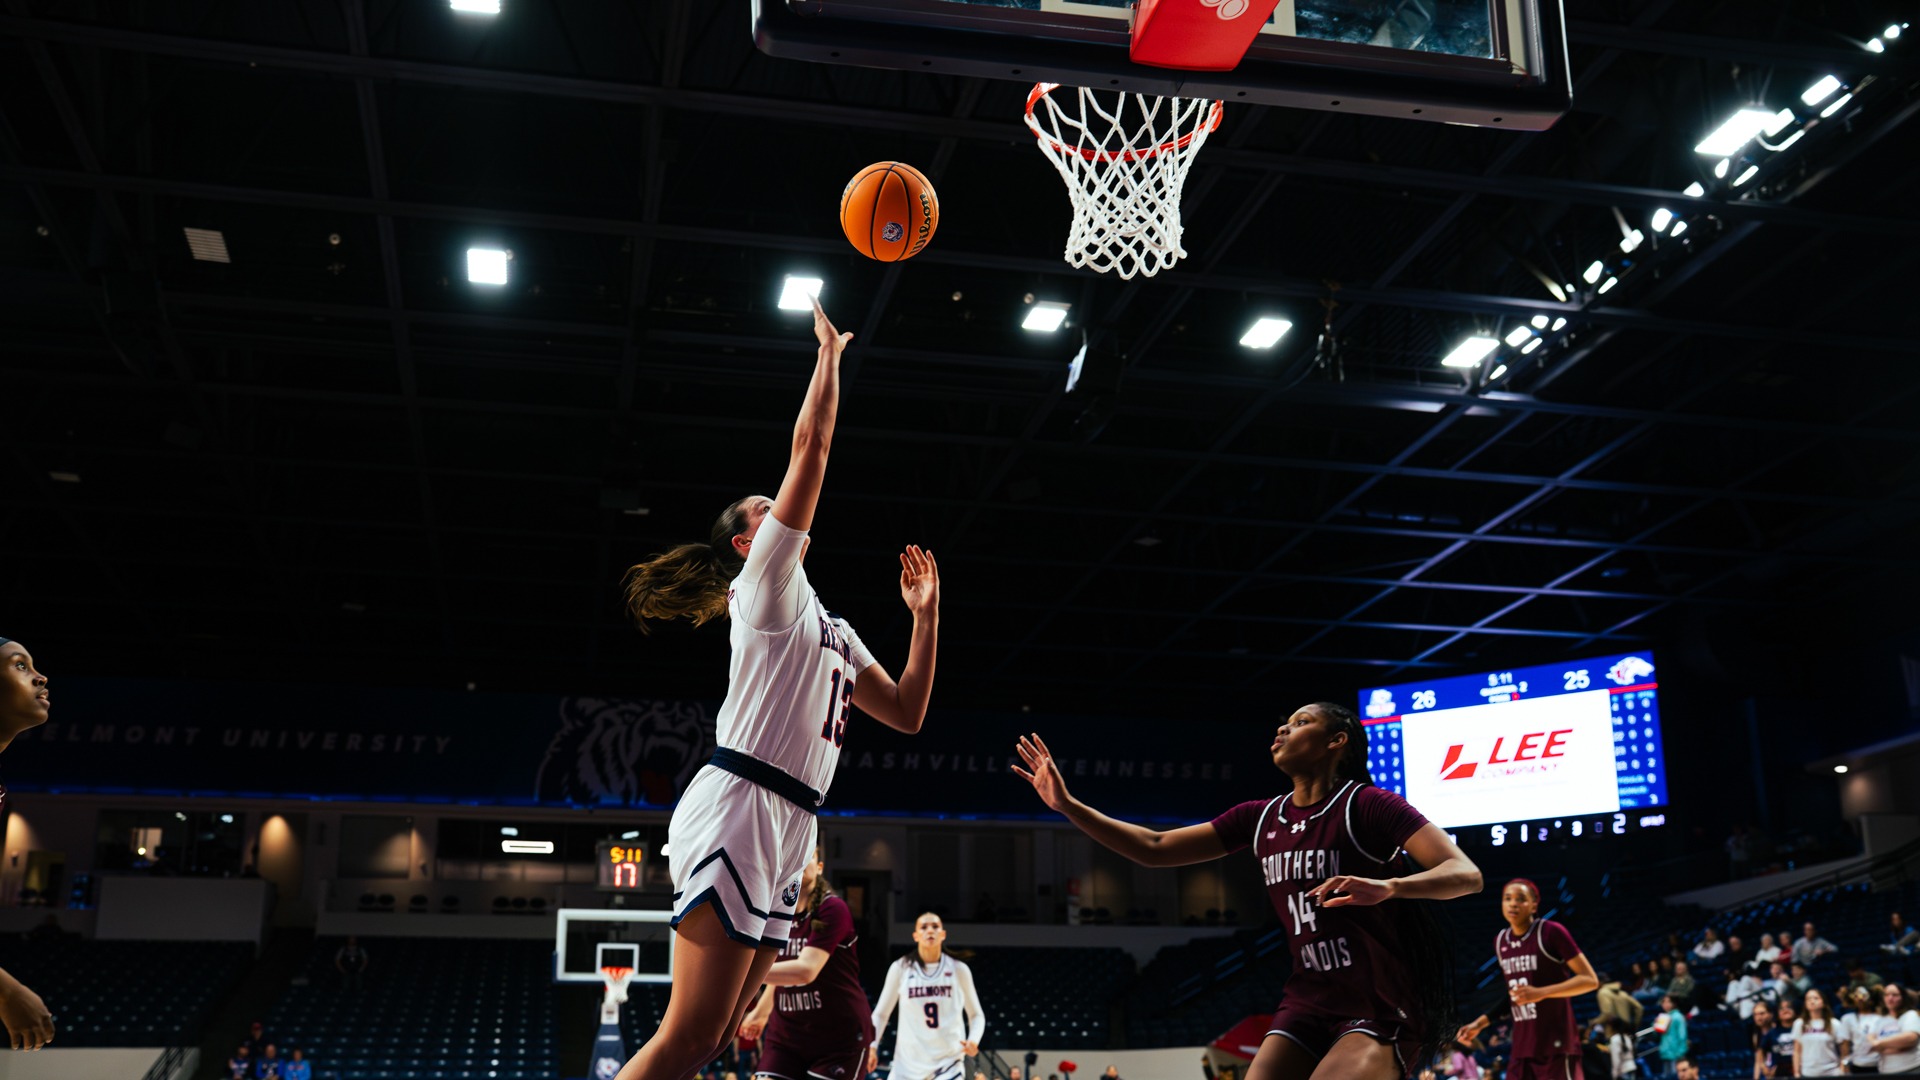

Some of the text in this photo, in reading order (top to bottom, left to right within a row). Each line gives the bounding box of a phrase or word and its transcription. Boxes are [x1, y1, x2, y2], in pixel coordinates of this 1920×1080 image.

[909, 192, 931, 255] Wilson
[1563, 669, 1590, 691] 25
[821, 667, 855, 749] 13
[1411, 690, 1436, 710] 26
[222, 727, 451, 754] UNIVERSITY
[1487, 728, 1573, 765] LEE
[1055, 758, 1233, 781] TENNESSEE
[610, 846, 642, 863] 5:11
[1262, 849, 1339, 886] SOUTHERN
[614, 862, 637, 888] 17
[1287, 891, 1316, 935] 14
[779, 990, 822, 1012] ILLINOIS
[908, 985, 952, 999] BELMONT
[924, 1002, 939, 1029] 9
